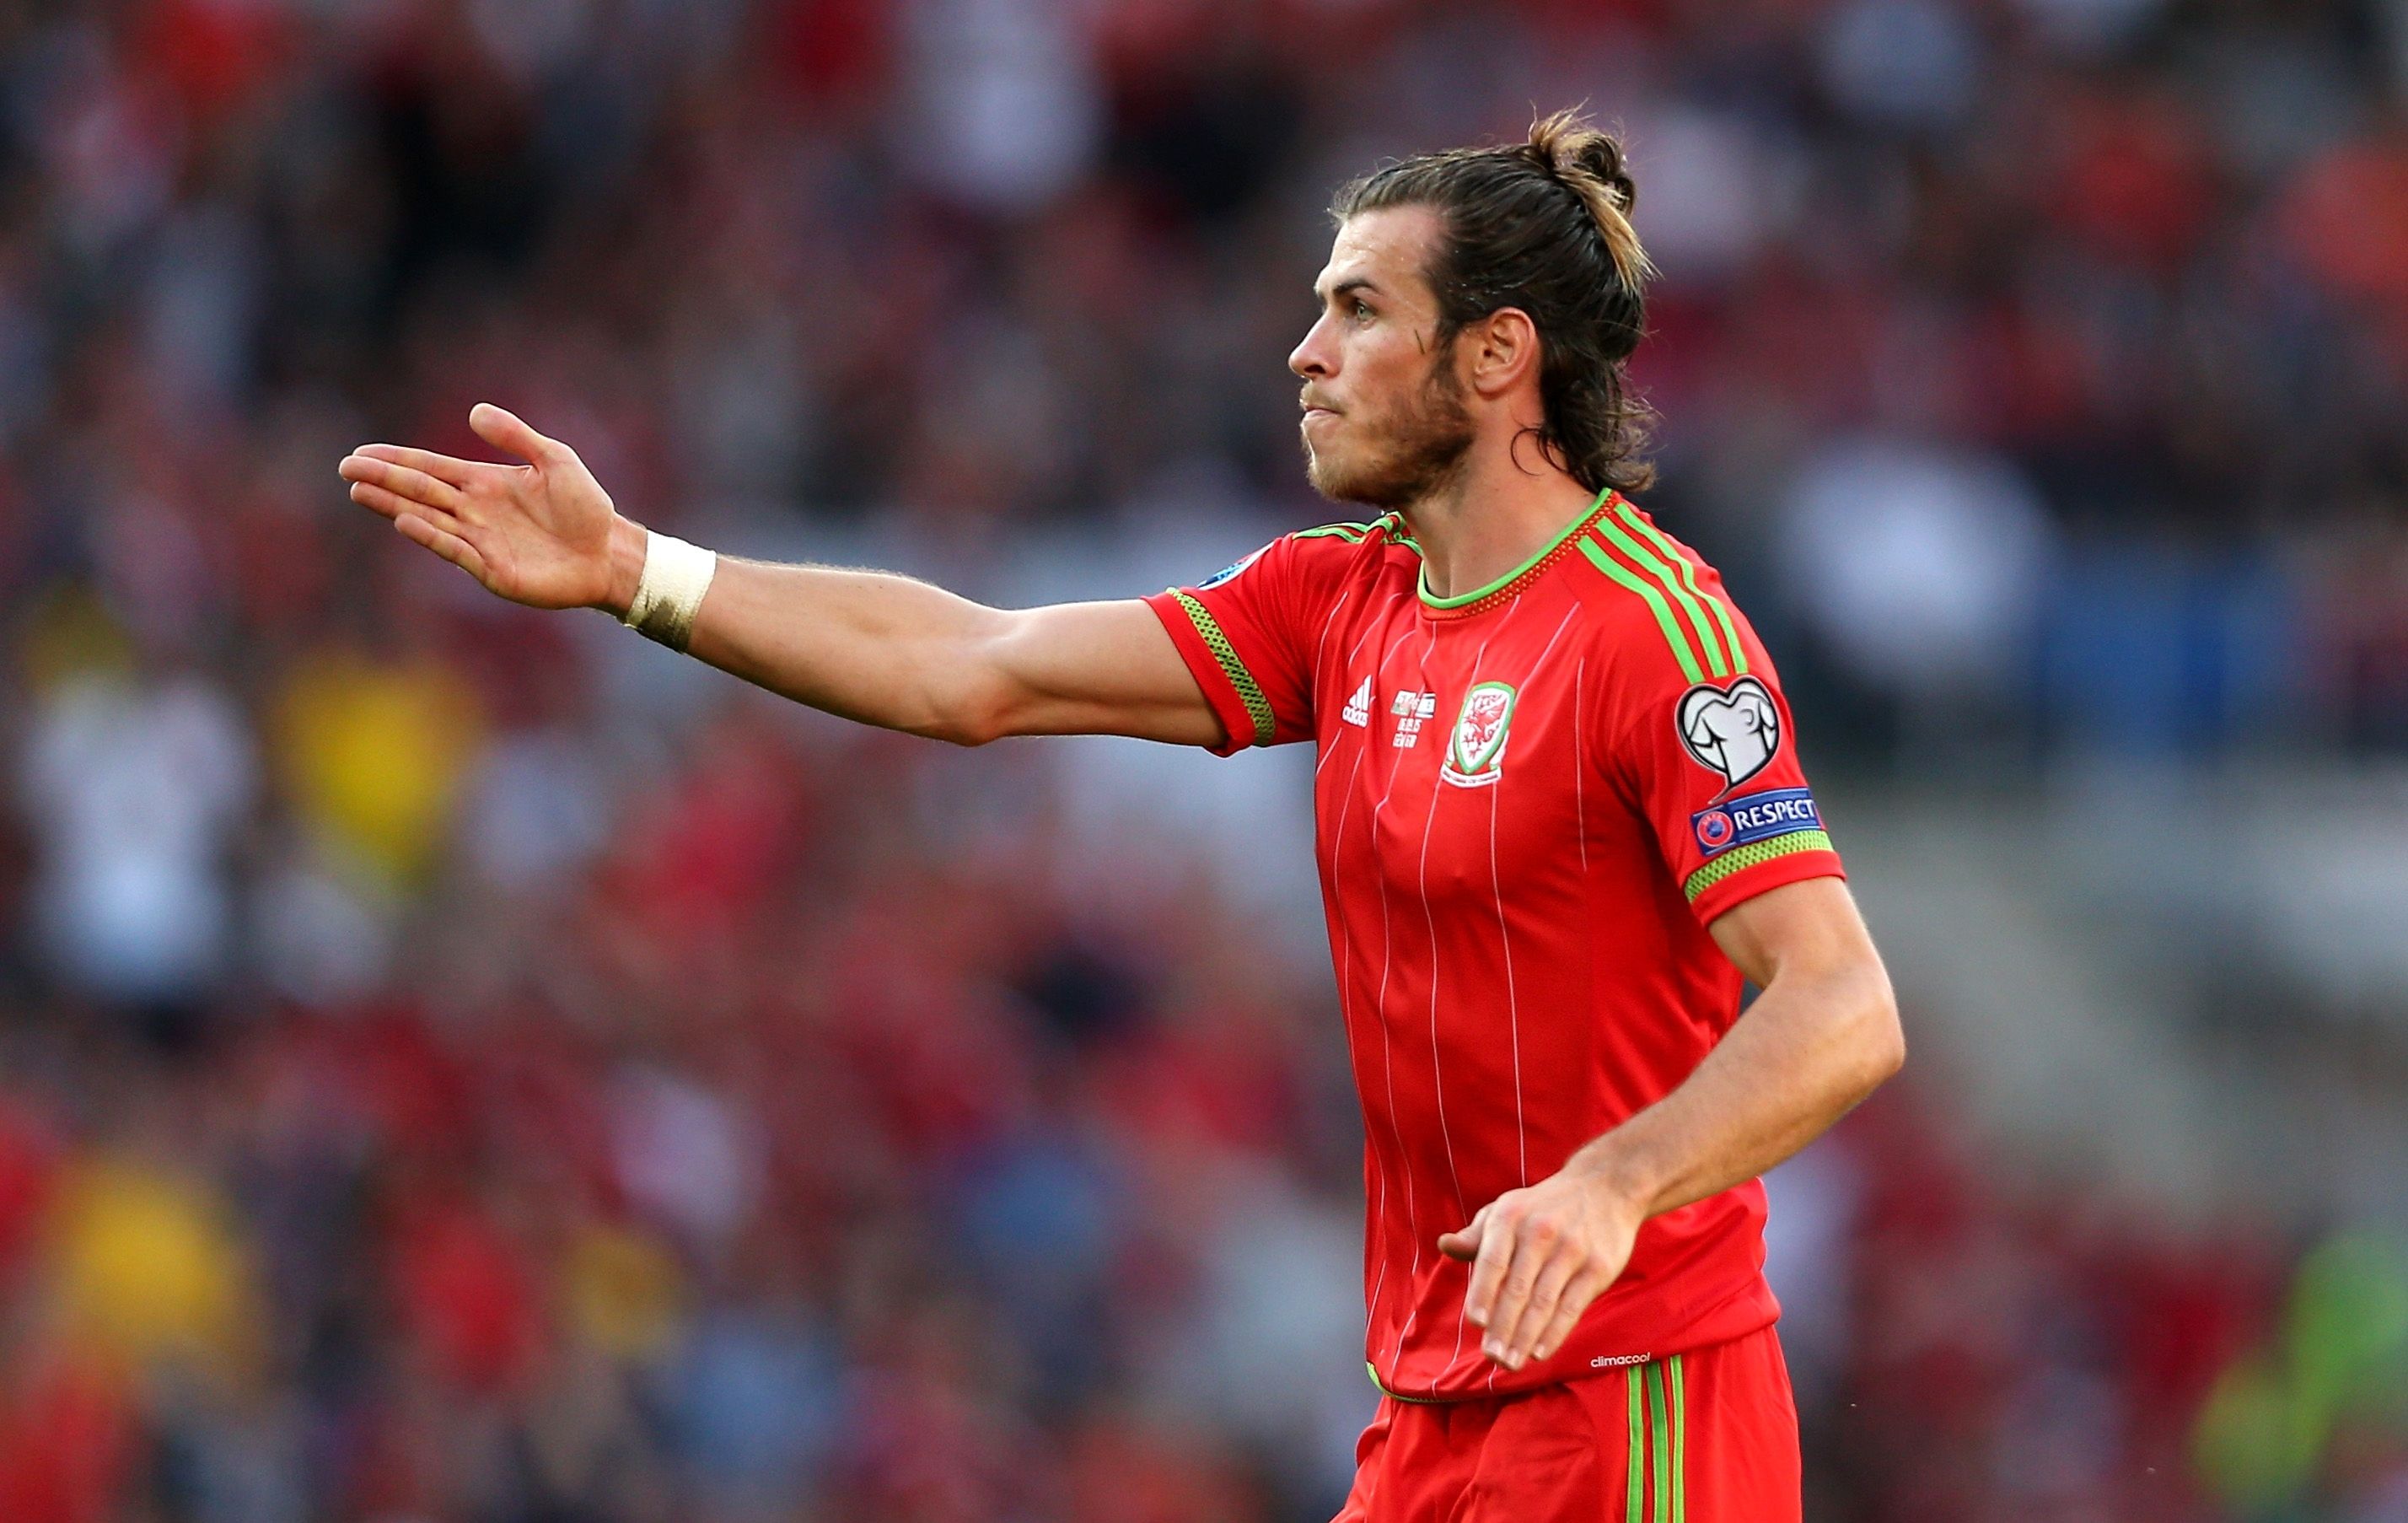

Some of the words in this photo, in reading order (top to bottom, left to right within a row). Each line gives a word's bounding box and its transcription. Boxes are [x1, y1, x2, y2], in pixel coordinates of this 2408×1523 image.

[1342, 706, 1368, 728] adidas
[1733, 799, 1816, 831] RESPECT
[1590, 1352, 1651, 1368] climacool
